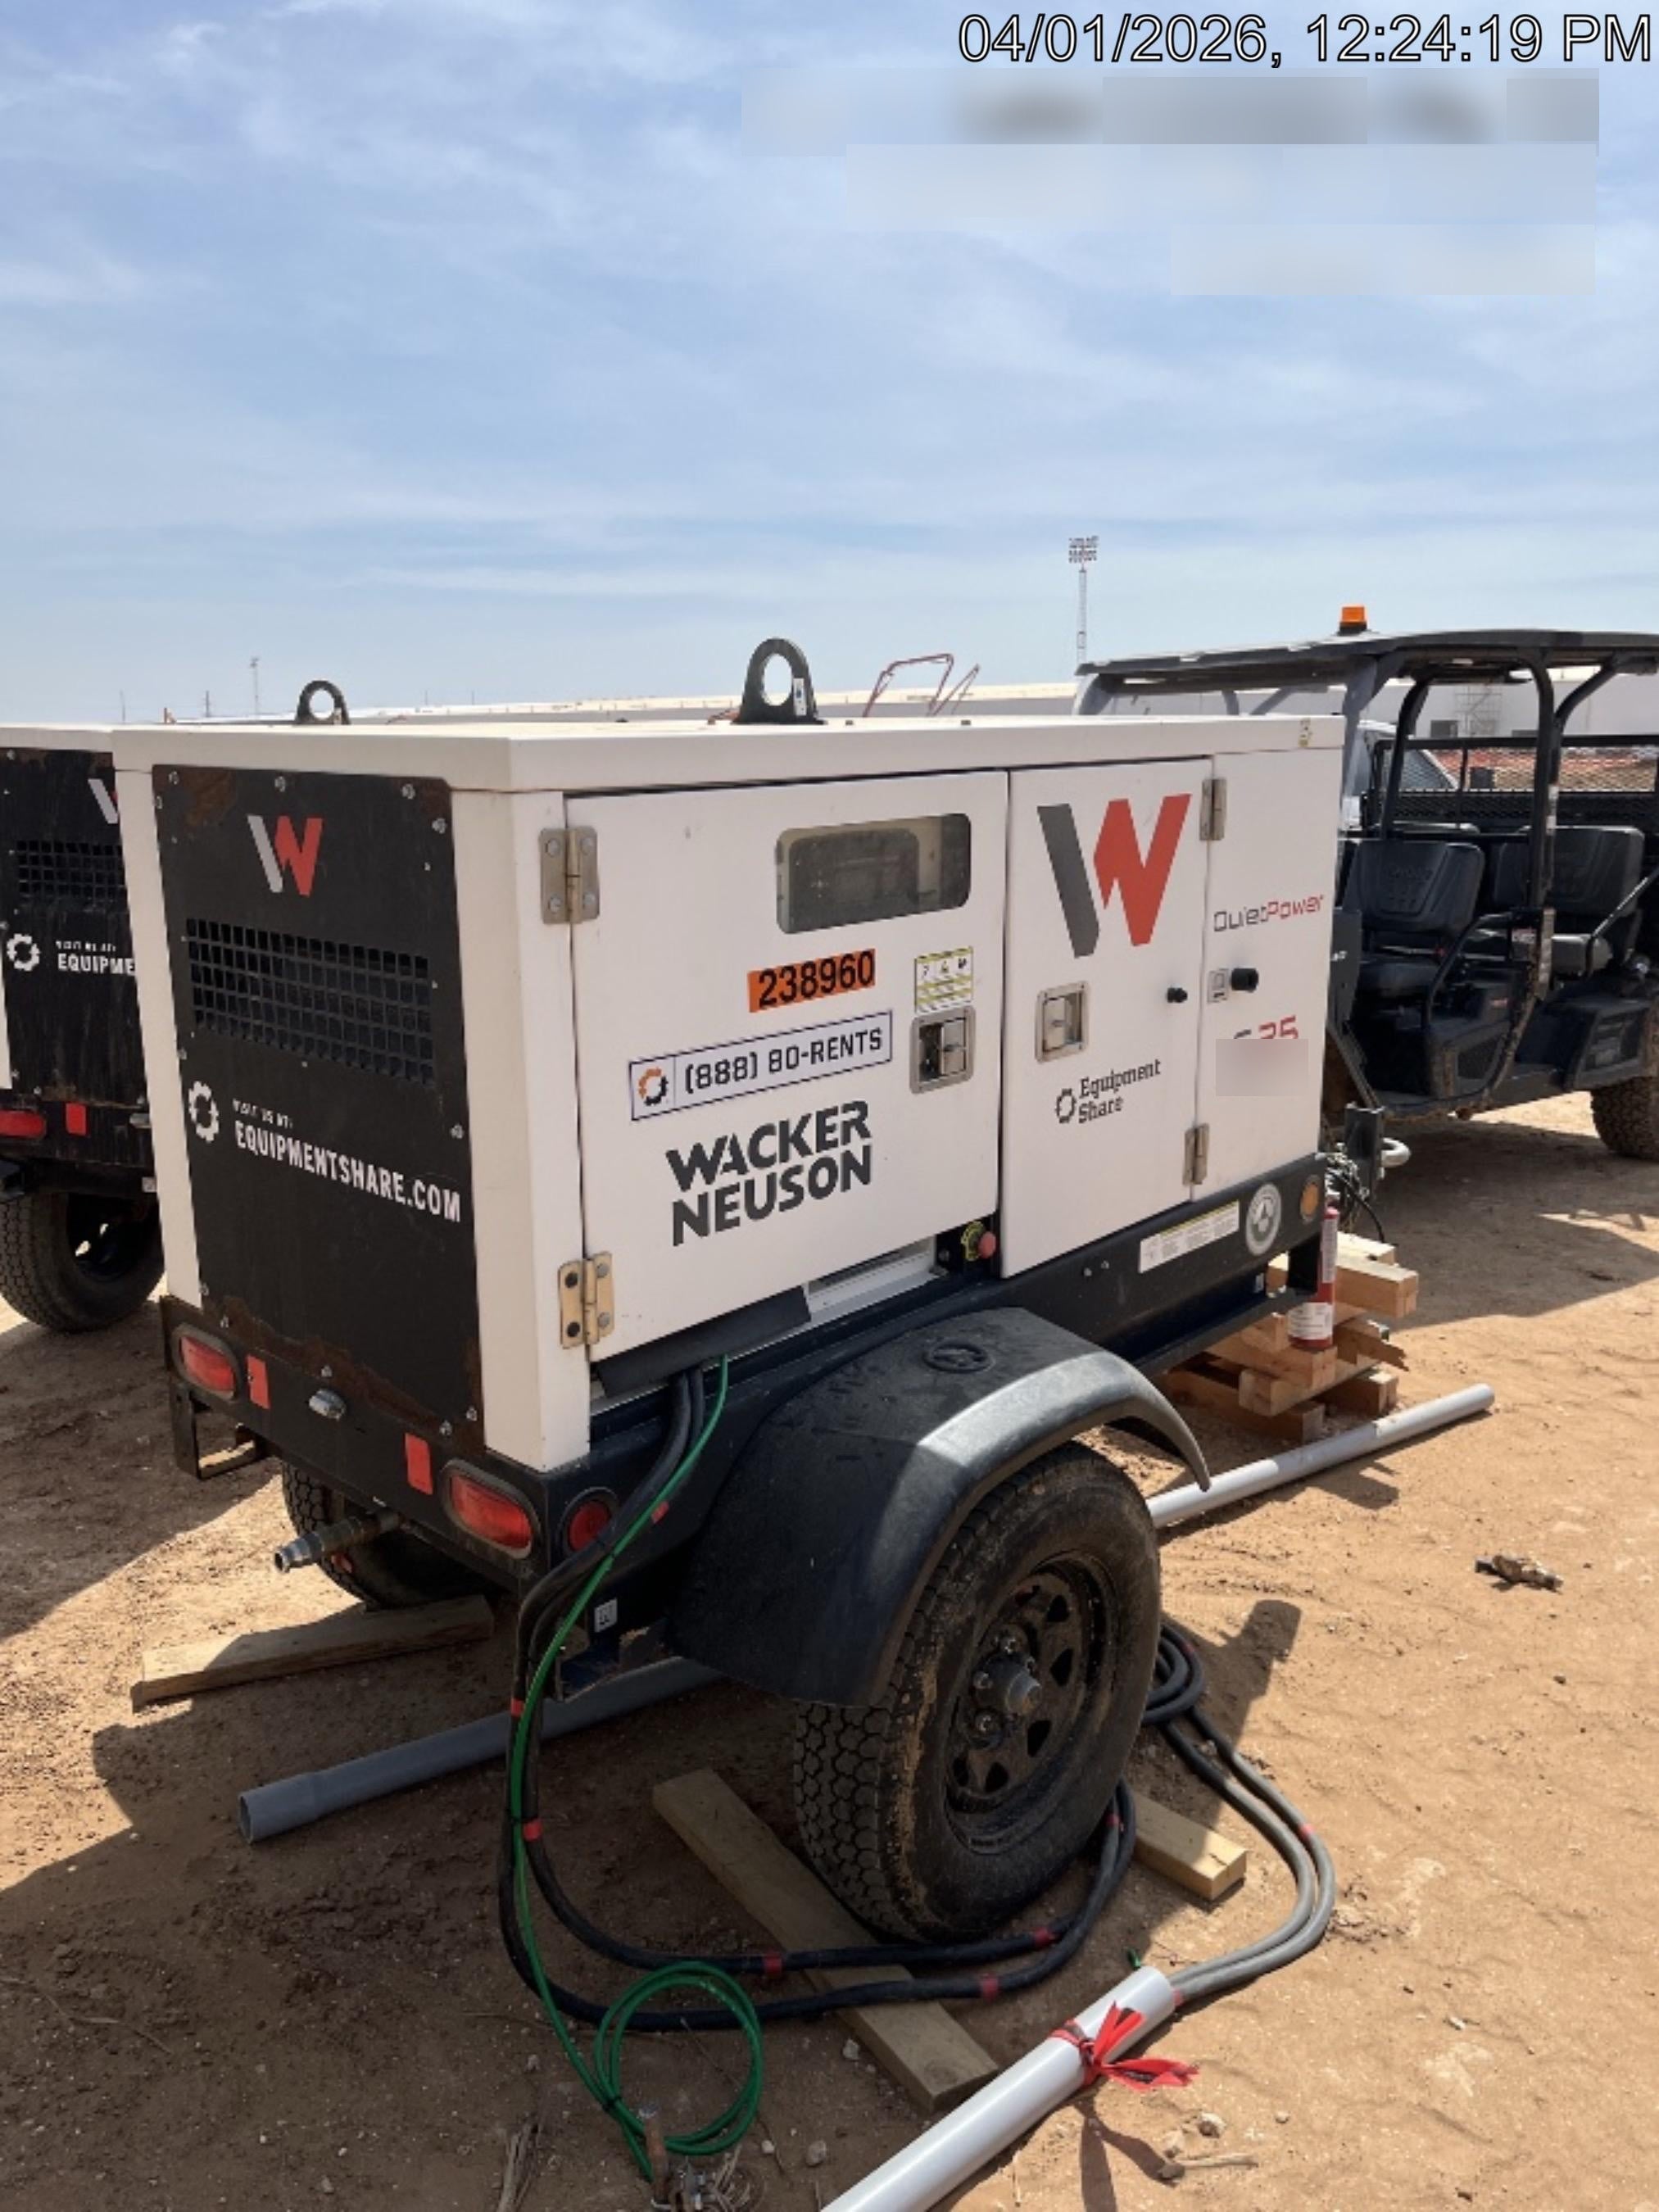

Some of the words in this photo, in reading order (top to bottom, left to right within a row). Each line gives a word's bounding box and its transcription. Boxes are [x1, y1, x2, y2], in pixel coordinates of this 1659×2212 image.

[1213, 895, 1324, 932] QuietPower
[757, 949, 874, 1010] 238960
[685, 1050, 759, 1095] (888)
[768, 1027, 882, 1073] 80-RENTS
[1079, 1058, 1162, 1099] Equipment
[1077, 1096, 1123, 1124] Share
[234, 1119, 462, 1223] EQUIPMENTSHARE.COM
[665, 1099, 873, 1193] WACKER
[672, 1144, 873, 1247] NEUSON
